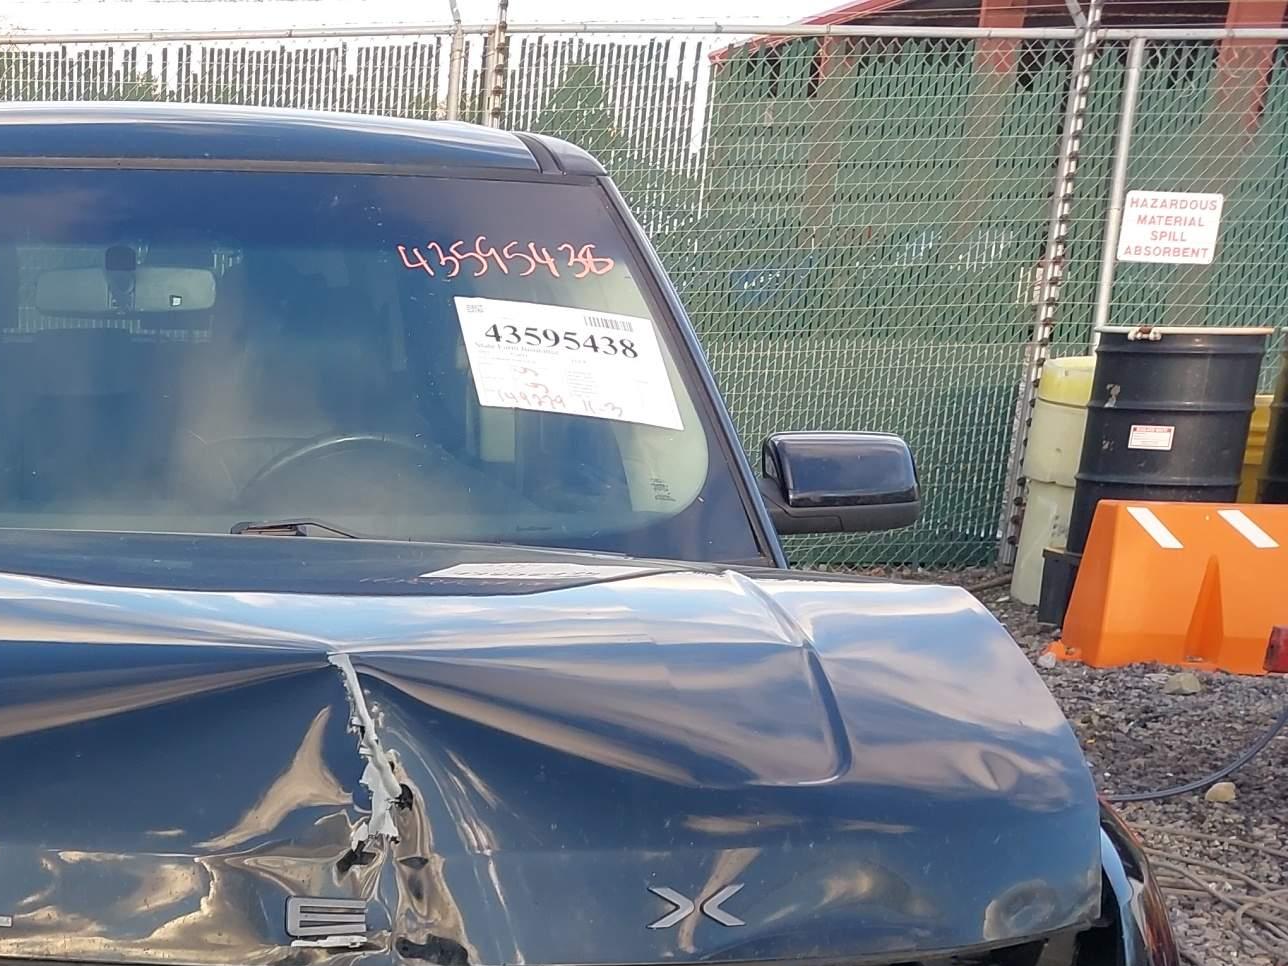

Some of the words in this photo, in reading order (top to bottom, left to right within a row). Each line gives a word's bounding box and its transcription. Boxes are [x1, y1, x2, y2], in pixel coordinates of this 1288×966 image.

[1129, 197, 1218, 211] HAZARDOUS
[1136, 214, 1206, 227] MATERIAL
[1149, 230, 1188, 242] SPILL
[1123, 245, 1209, 258] ABSORBENT
[484, 323, 639, 359] 43595438
